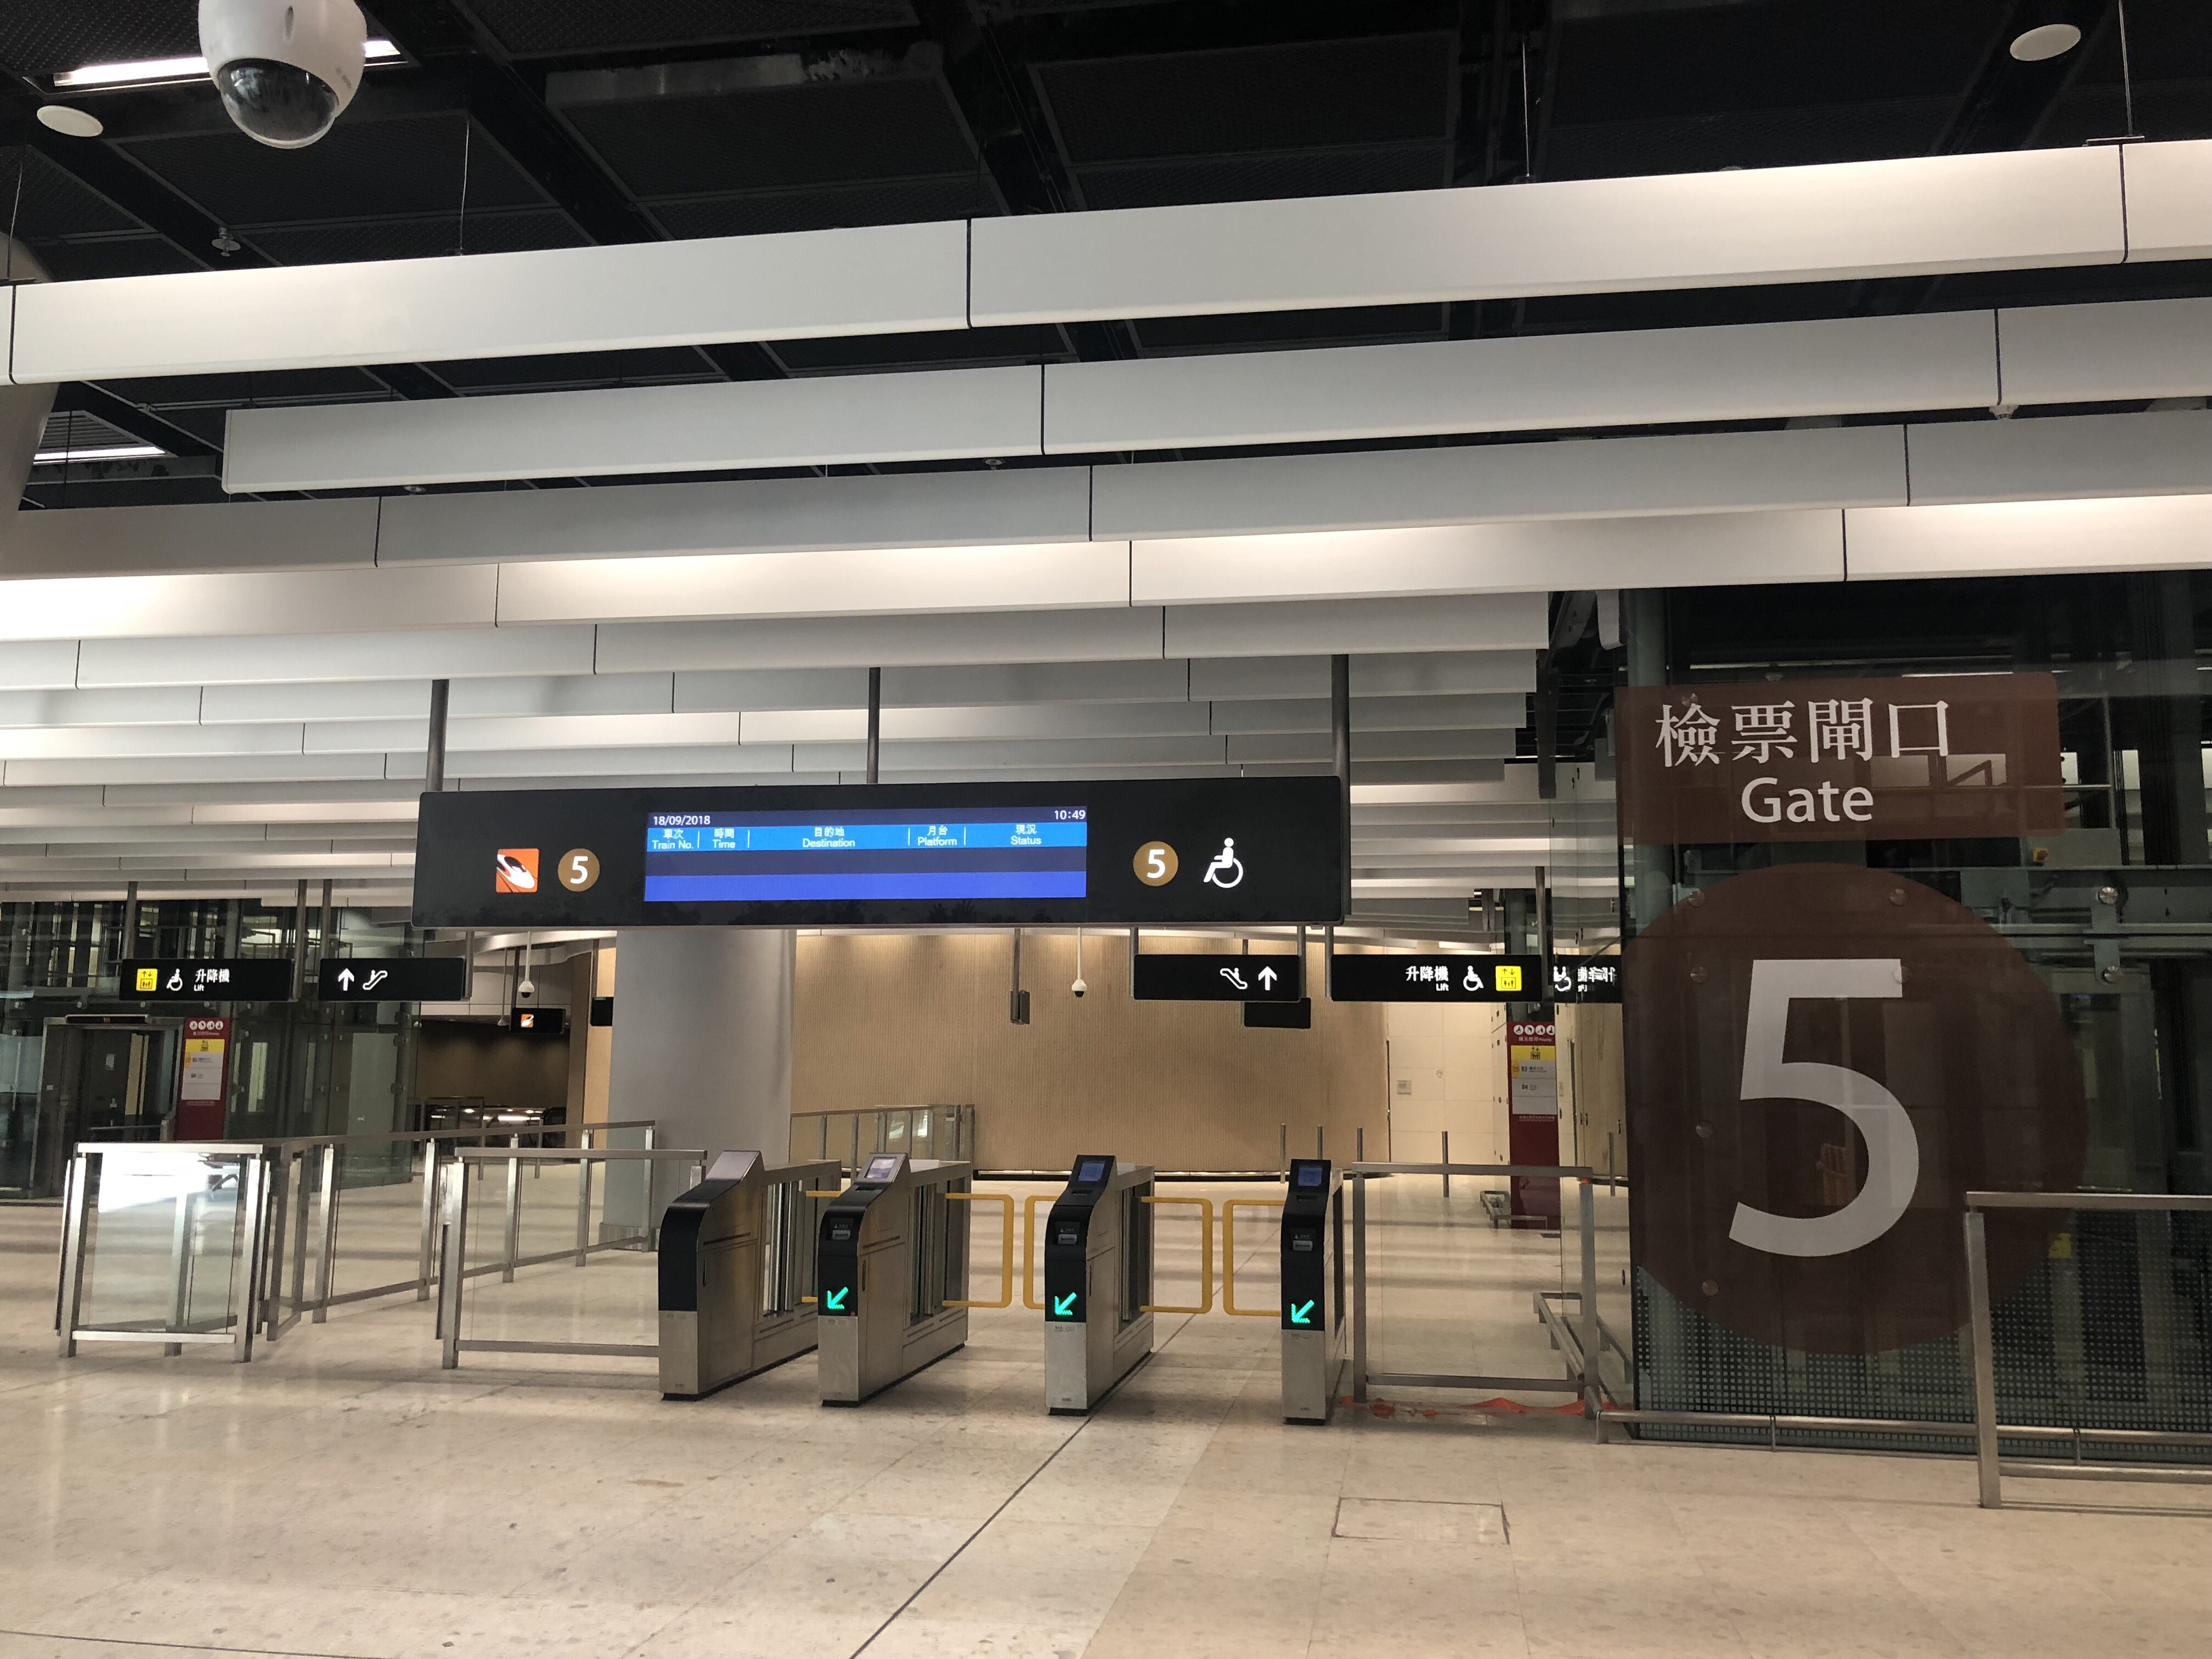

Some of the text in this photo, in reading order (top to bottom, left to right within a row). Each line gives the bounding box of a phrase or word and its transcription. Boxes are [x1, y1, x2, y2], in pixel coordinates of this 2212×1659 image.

[1655, 697, 1950, 768] 檢票閘口
[1741, 776, 1874, 823] Gate
[1054, 809, 1086, 820] 10:49
[653, 815, 711, 826] 18/09/2018
[663, 828, 684, 839] 車次
[814, 827, 845, 838] 目的地
[927, 825, 949, 836] 月台
[1015, 823, 1037, 835] 現況
[652, 839, 694, 849] Train No.
[712, 839, 736, 849] Time
[803, 838, 855, 848] Destination
[917, 837, 957, 847] Platform
[1011, 836, 1042, 845] Status
[1147, 848, 1167, 879] 5
[569, 855, 589, 884] 5
[195, 968, 230, 983] 升降機
[1405, 966, 1449, 982] 升降機
[1436, 983, 1449, 991] Lift
[1728, 958, 1920, 1258] 5
